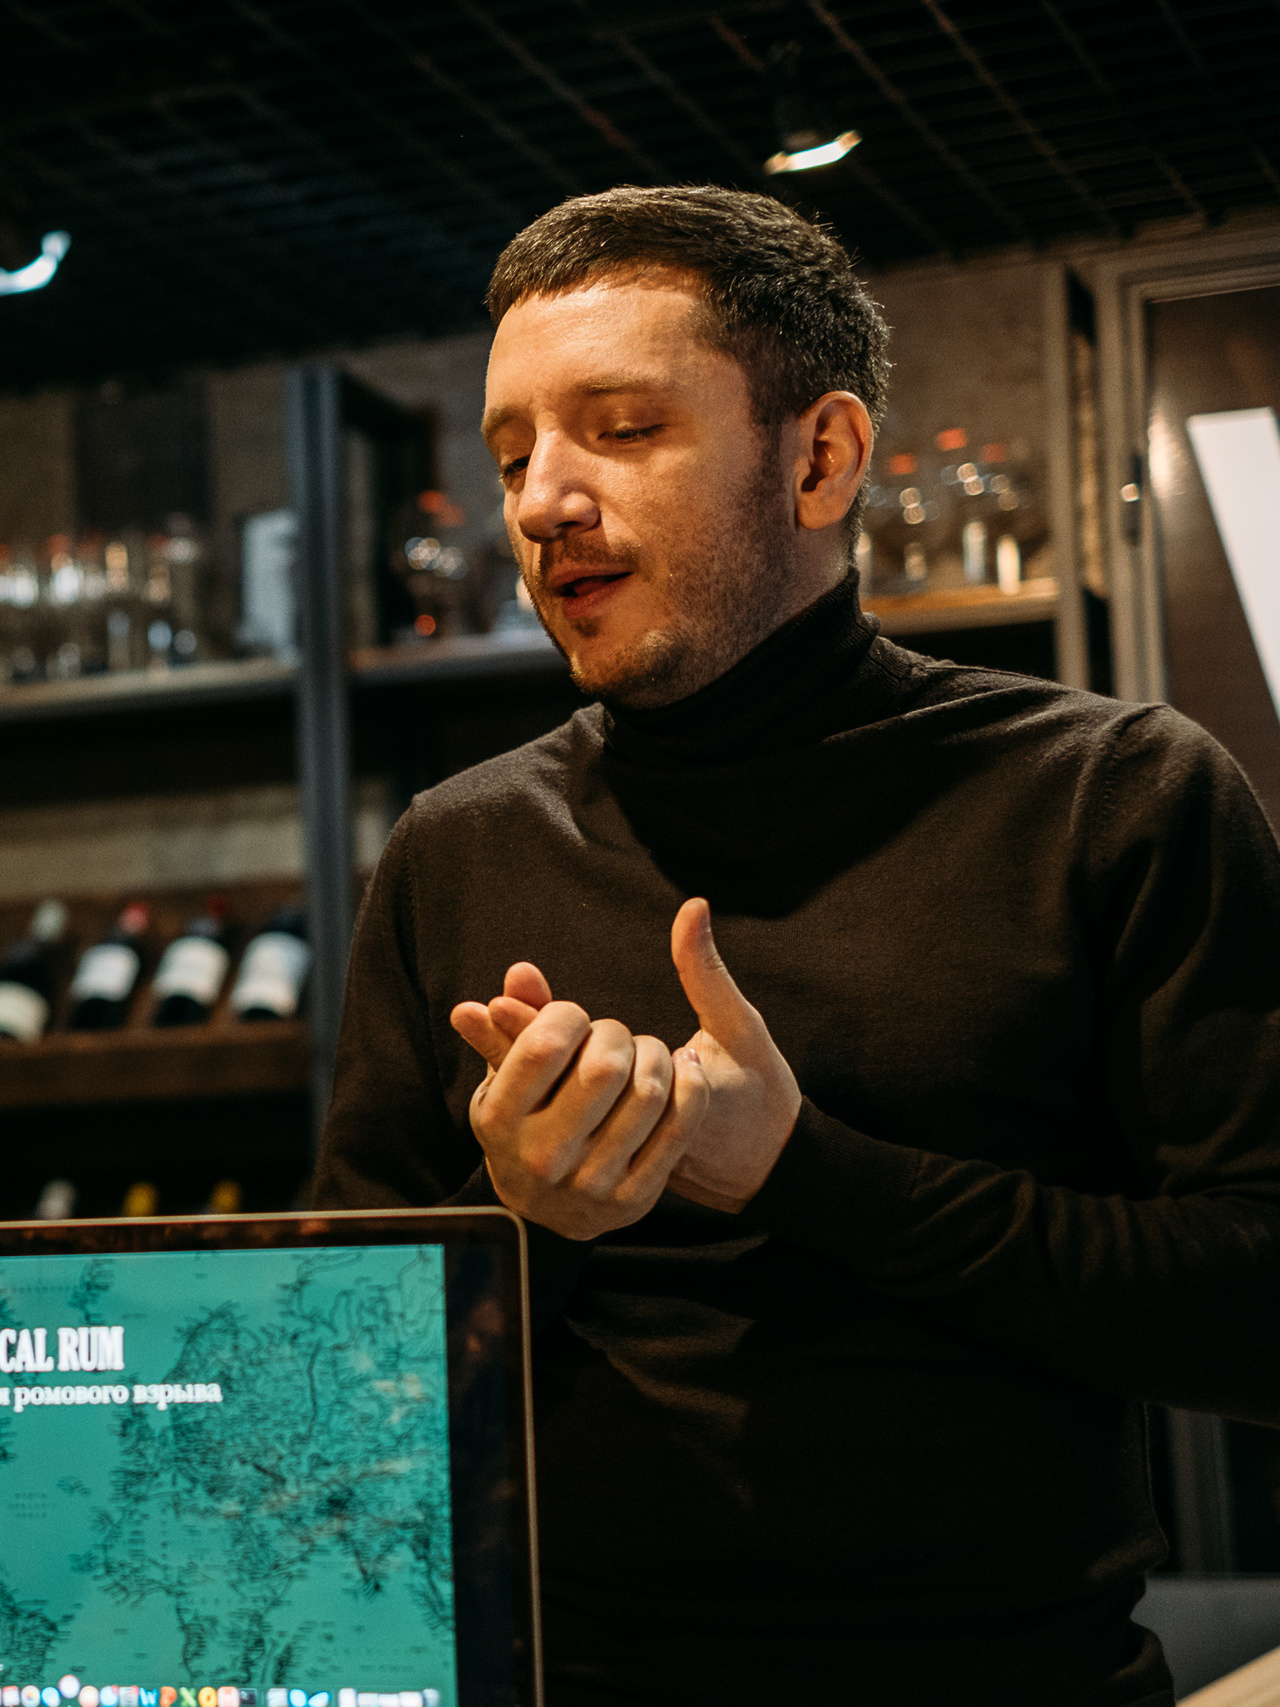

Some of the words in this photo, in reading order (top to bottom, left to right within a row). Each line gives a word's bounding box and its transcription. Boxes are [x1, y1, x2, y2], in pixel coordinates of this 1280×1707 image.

[57, 1325, 124, 1371] RUM
[13, 1384, 129, 1413] ромового
[132, 1382, 223, 1410] взрыва
